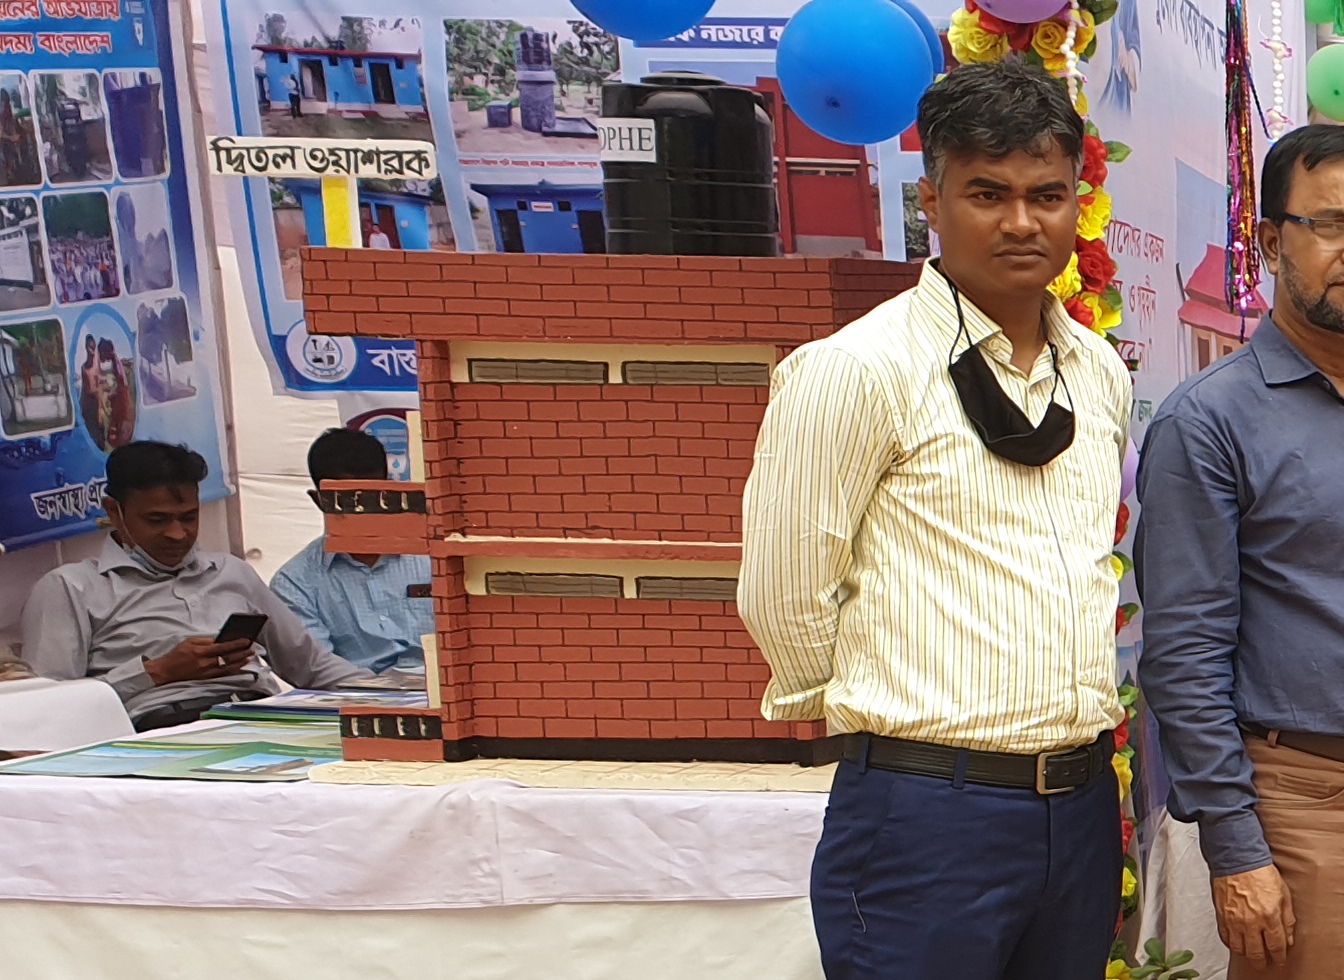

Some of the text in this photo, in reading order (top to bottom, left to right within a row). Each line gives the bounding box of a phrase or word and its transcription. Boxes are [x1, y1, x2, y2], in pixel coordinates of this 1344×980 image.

[0, 0, 40, 20] য়নের
[37, 32, 112, 56] বাংলাদেশ
[700, 25, 765, 44] নজরে
[210, 137, 301, 174] দ্বিতল
